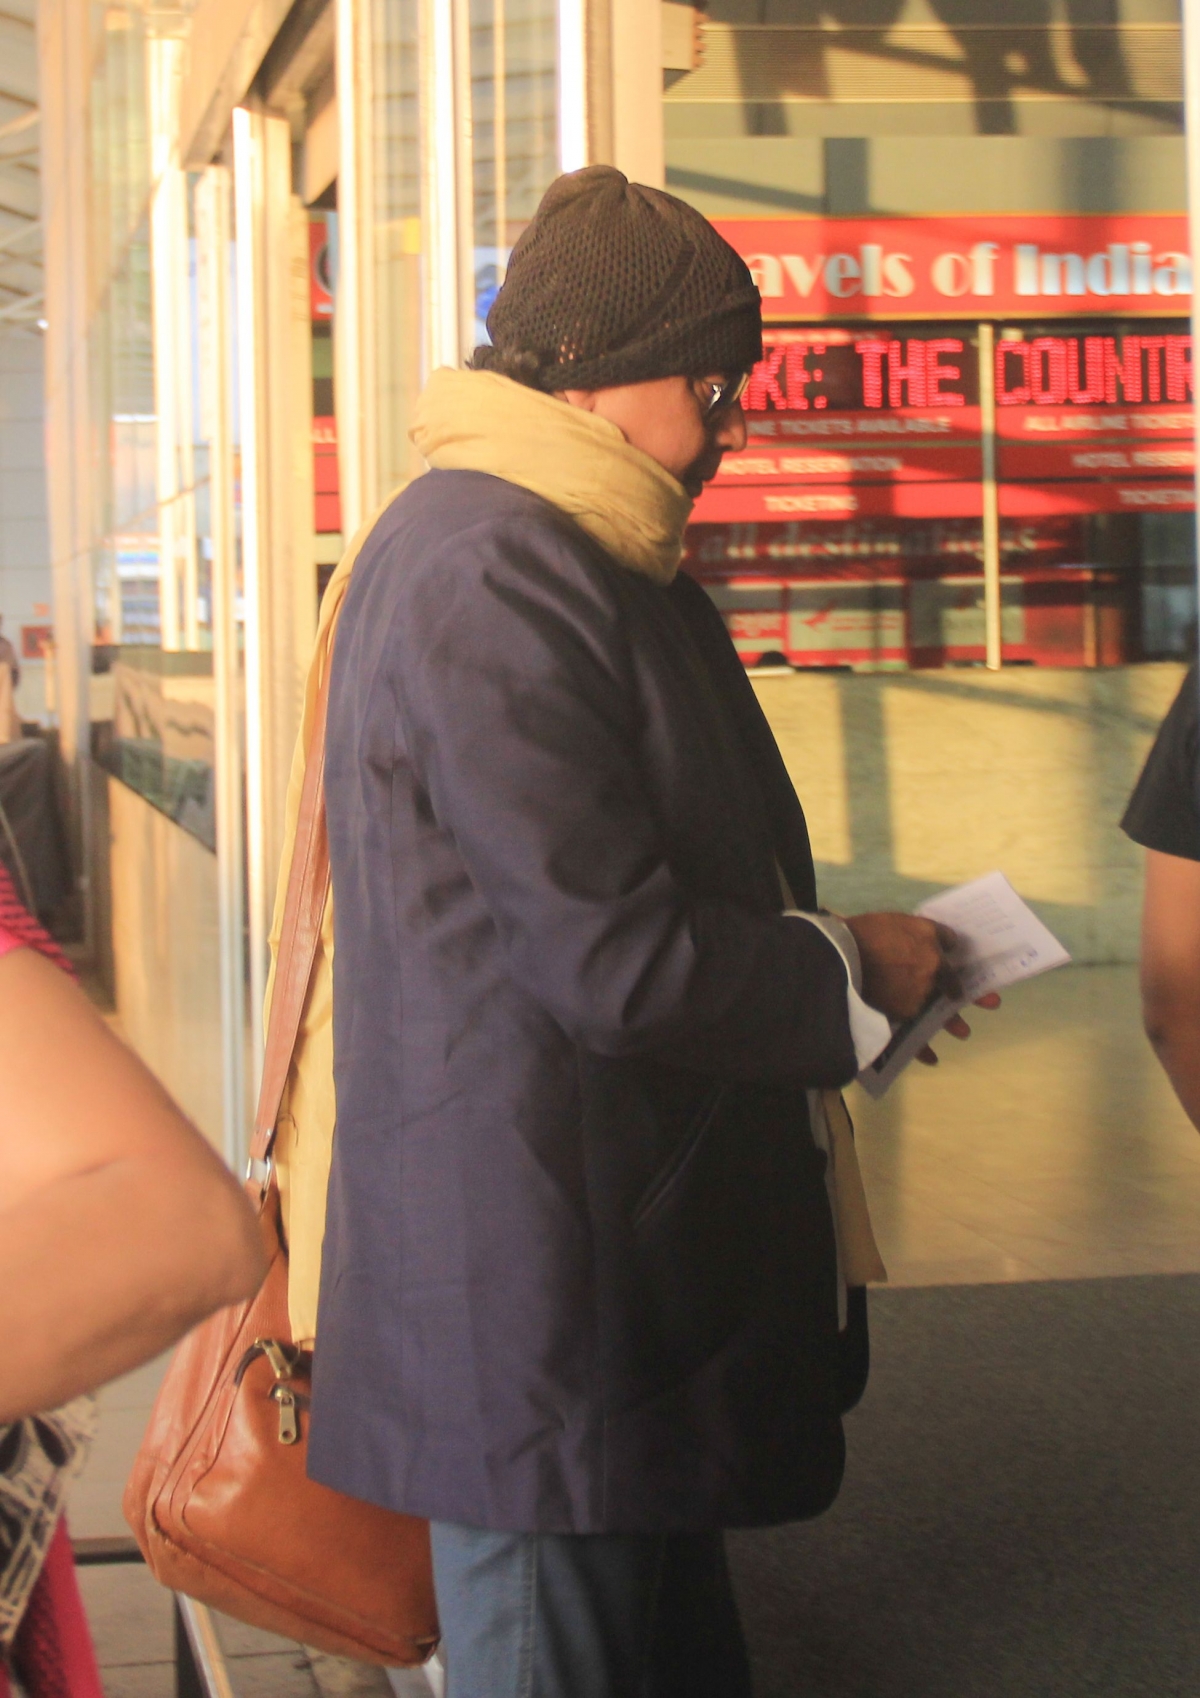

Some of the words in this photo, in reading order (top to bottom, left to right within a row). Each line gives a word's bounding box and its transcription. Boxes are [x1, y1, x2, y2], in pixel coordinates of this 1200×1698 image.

[931, 242, 998, 297] of
[1014, 242, 1195, 296] India
[855, 338, 966, 408] THE
[780, 418, 852, 435] TICKETS
[857, 417, 951, 433] AVAILABLE
[1025, 416, 1059, 431] ALL
[1060, 414, 1129, 430] AIRLINE
[780, 455, 902, 474] RESERVATION
[1072, 453, 1131, 469] HOTEL
[763, 494, 858, 512] TICKETING
